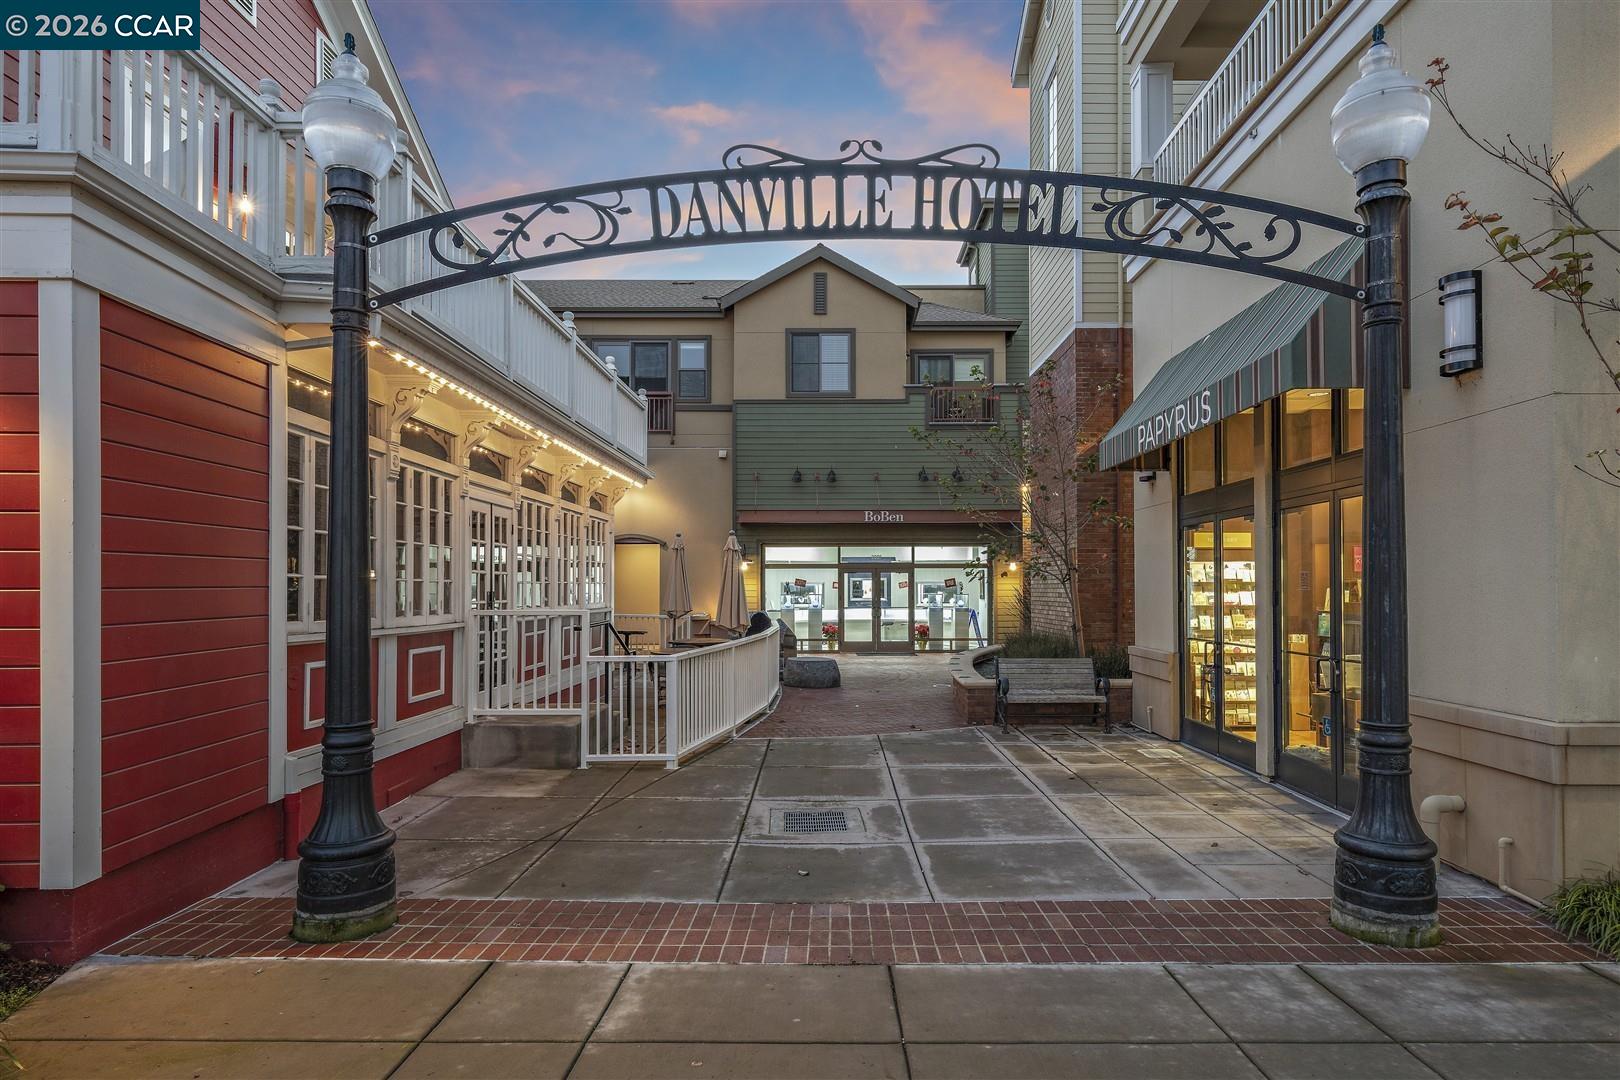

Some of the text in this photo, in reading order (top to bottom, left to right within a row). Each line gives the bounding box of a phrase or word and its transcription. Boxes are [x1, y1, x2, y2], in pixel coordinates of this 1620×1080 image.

[646, 173, 1079, 241] DANVILLE HOTEL
[1137, 390, 1212, 452] PAPYRUS
[863, 510, 904, 522] BoBen
